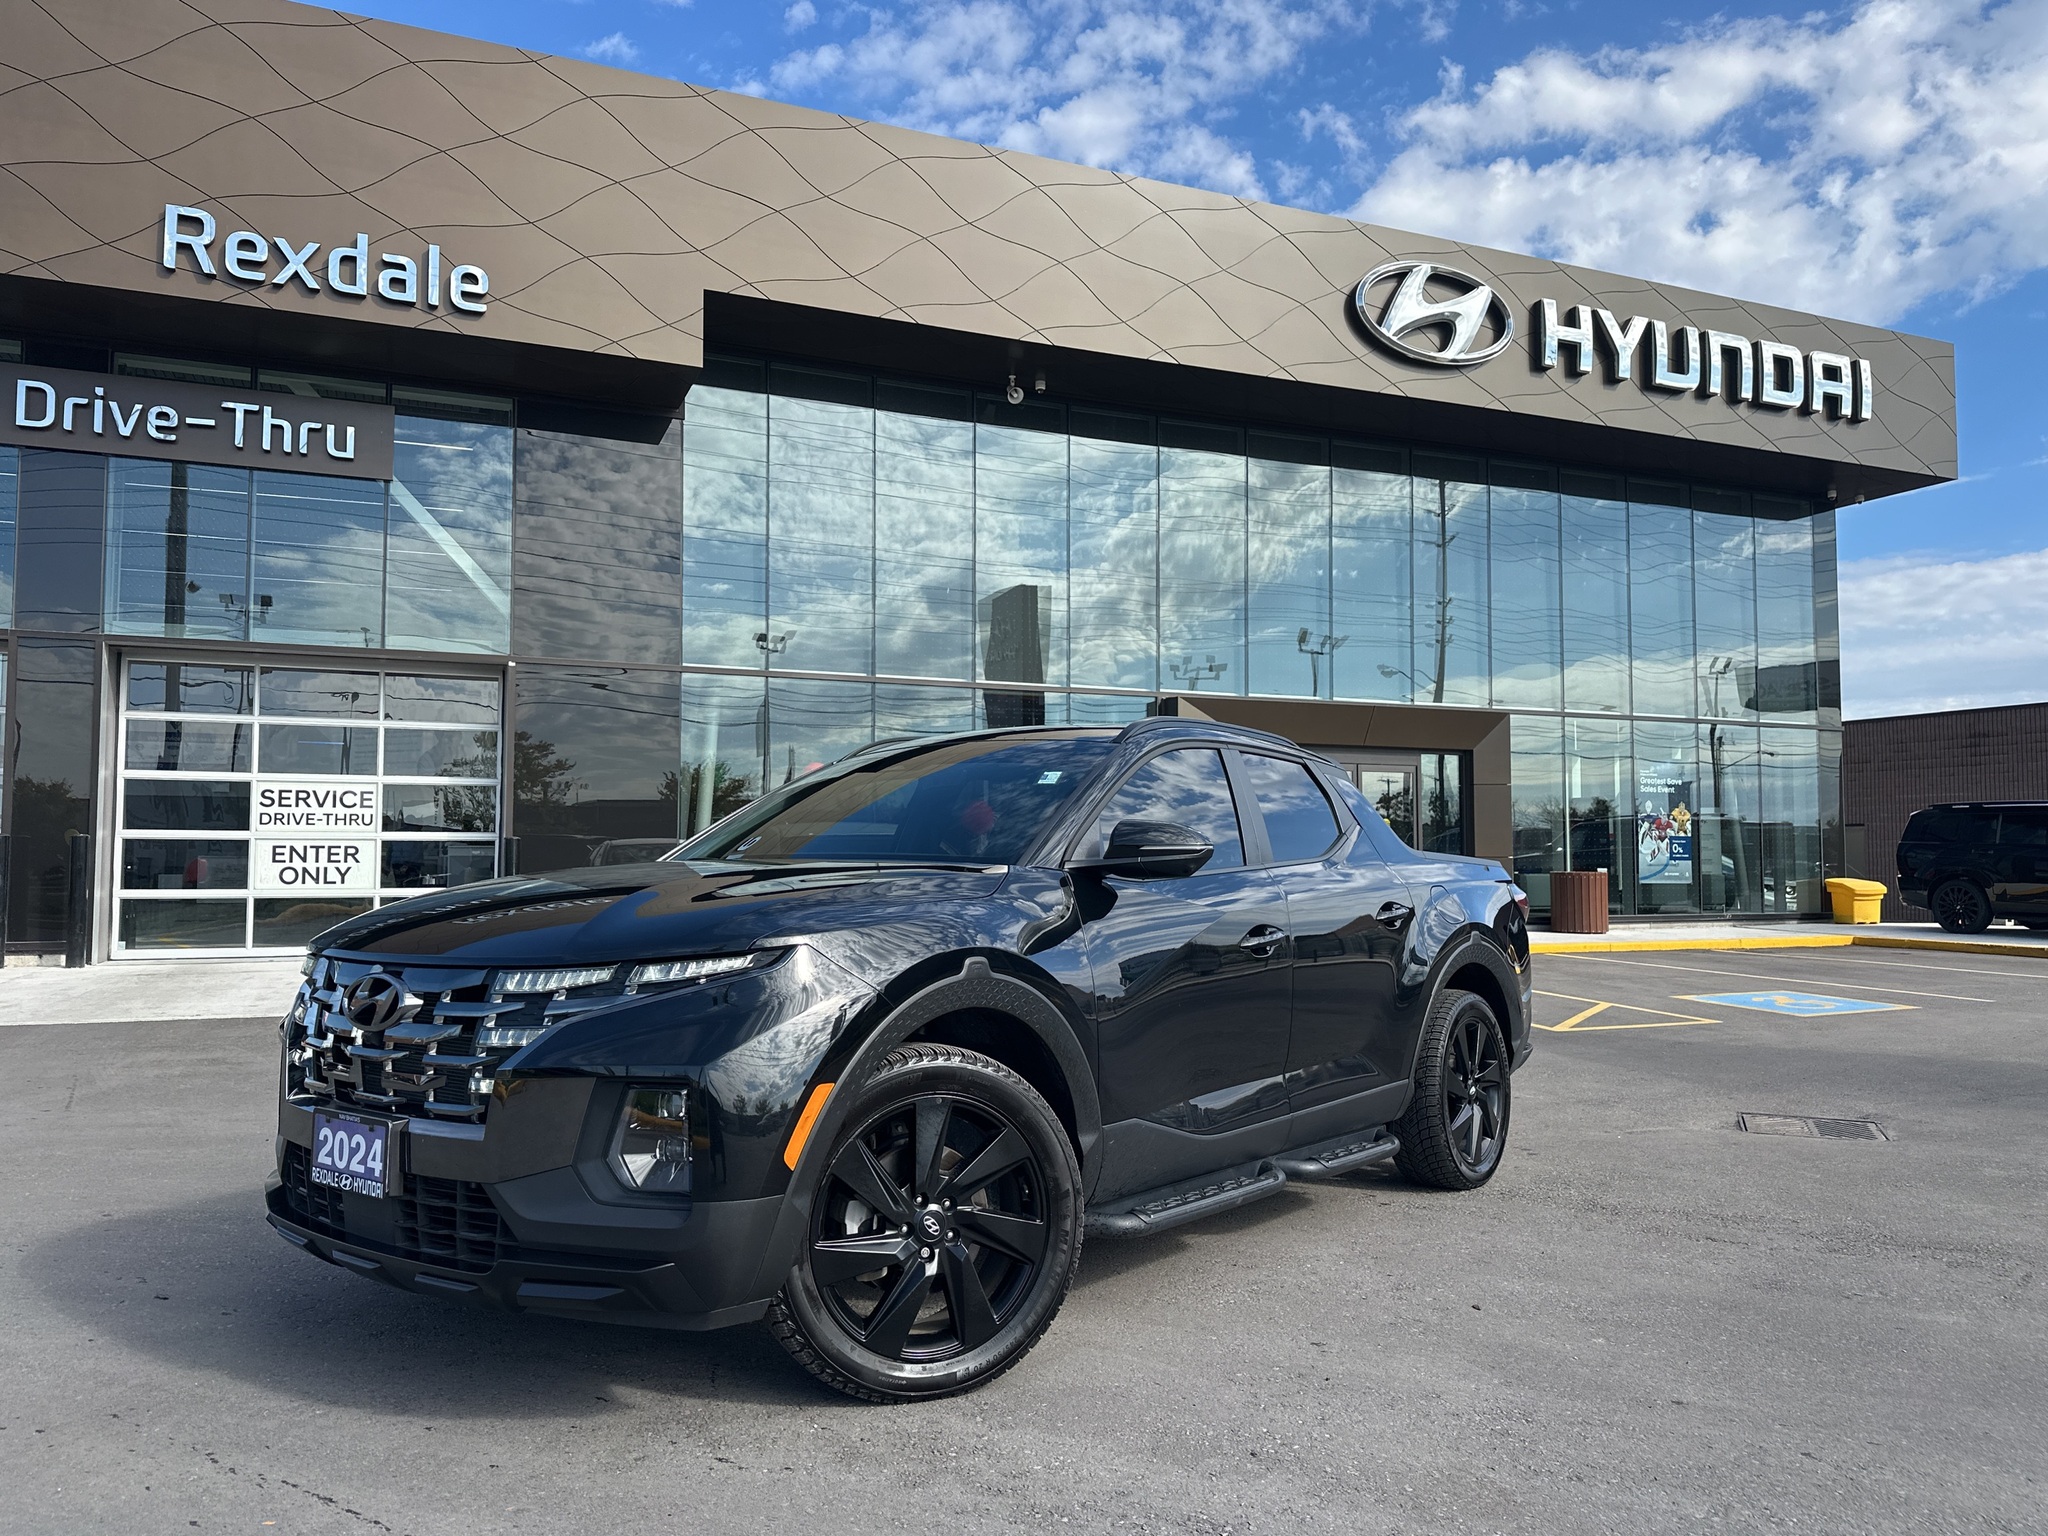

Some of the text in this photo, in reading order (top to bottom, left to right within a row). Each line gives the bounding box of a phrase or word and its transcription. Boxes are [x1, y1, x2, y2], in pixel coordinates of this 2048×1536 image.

[163, 203, 489, 313] Rexdale
[1537, 298, 1872, 421] HYUNDAI
[15, 379, 356, 460] Drive-Thru
[1640, 777, 1666, 785] Greatest
[1640, 785, 1656, 793] Sales
[259, 789, 373, 808] SERVICE
[259, 813, 374, 826] DRIVE-THRU
[272, 845, 360, 863] ENTER
[279, 866, 352, 885] ONLY
[317, 1127, 383, 1177] 2024
[312, 1166, 383, 1199] REXDALE HYUNDAI
